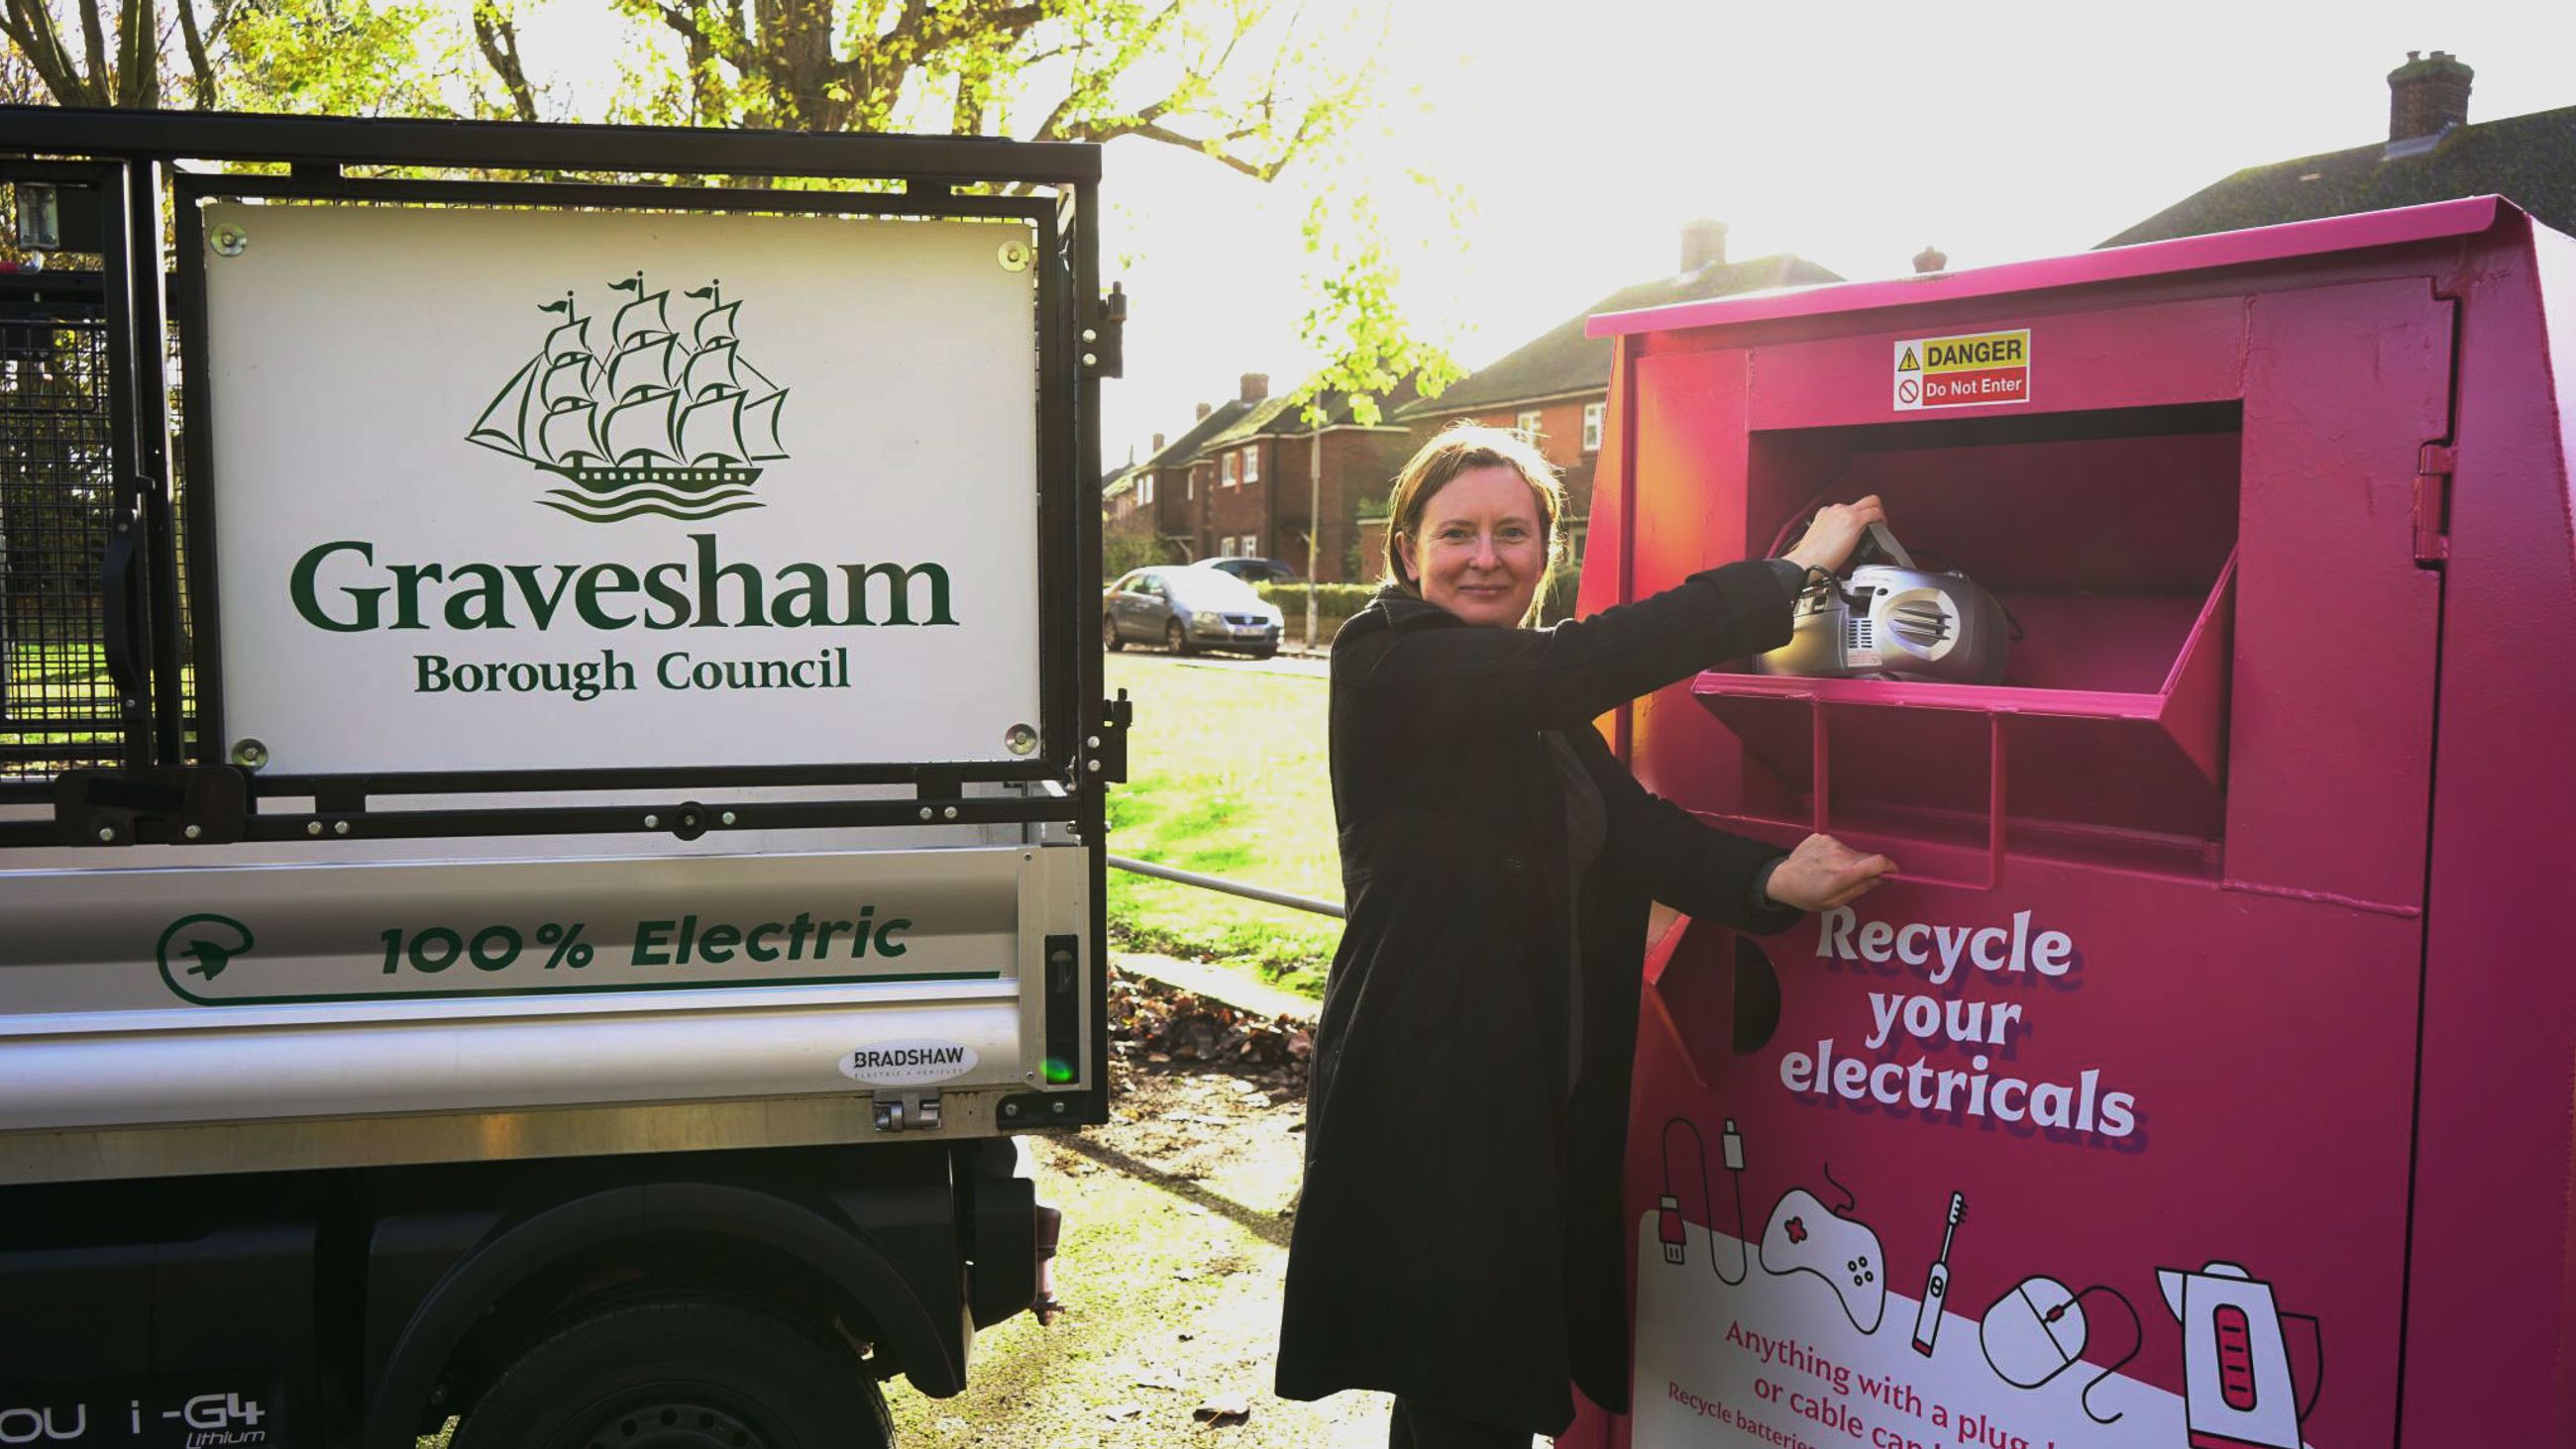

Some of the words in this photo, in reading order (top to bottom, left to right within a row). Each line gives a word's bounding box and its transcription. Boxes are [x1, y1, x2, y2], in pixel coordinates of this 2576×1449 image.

[1928, 339, 2022, 367] DANGER
[1926, 382, 1947, 397] Do
[1951, 379, 1978, 395] Not
[1982, 378, 2022, 393] Enter
[290, 534, 960, 633] Gravesham
[413, 649, 637, 701] Borough
[657, 648, 852, 690] Council
[631, 905, 913, 967] Electric
[1816, 905, 2073, 984] Recycle
[1865, 992, 2022, 1050] your
[854, 1047, 964, 1069] BRADSHAW
[1779, 1038, 2135, 1137] electricals
[1725, 1320, 1851, 1396] Anything
[1857, 1375, 1922, 1418] with
[1932, 1405, 1948, 1428] a
[1668, 1382, 1732, 1424] Recycle
[1736, 1409, 1815, 1449] batterie
[1754, 1378, 1783, 1403] or
[1789, 1393, 1864, 1438] cable
[186, 1431, 266, 1449] Lithium
